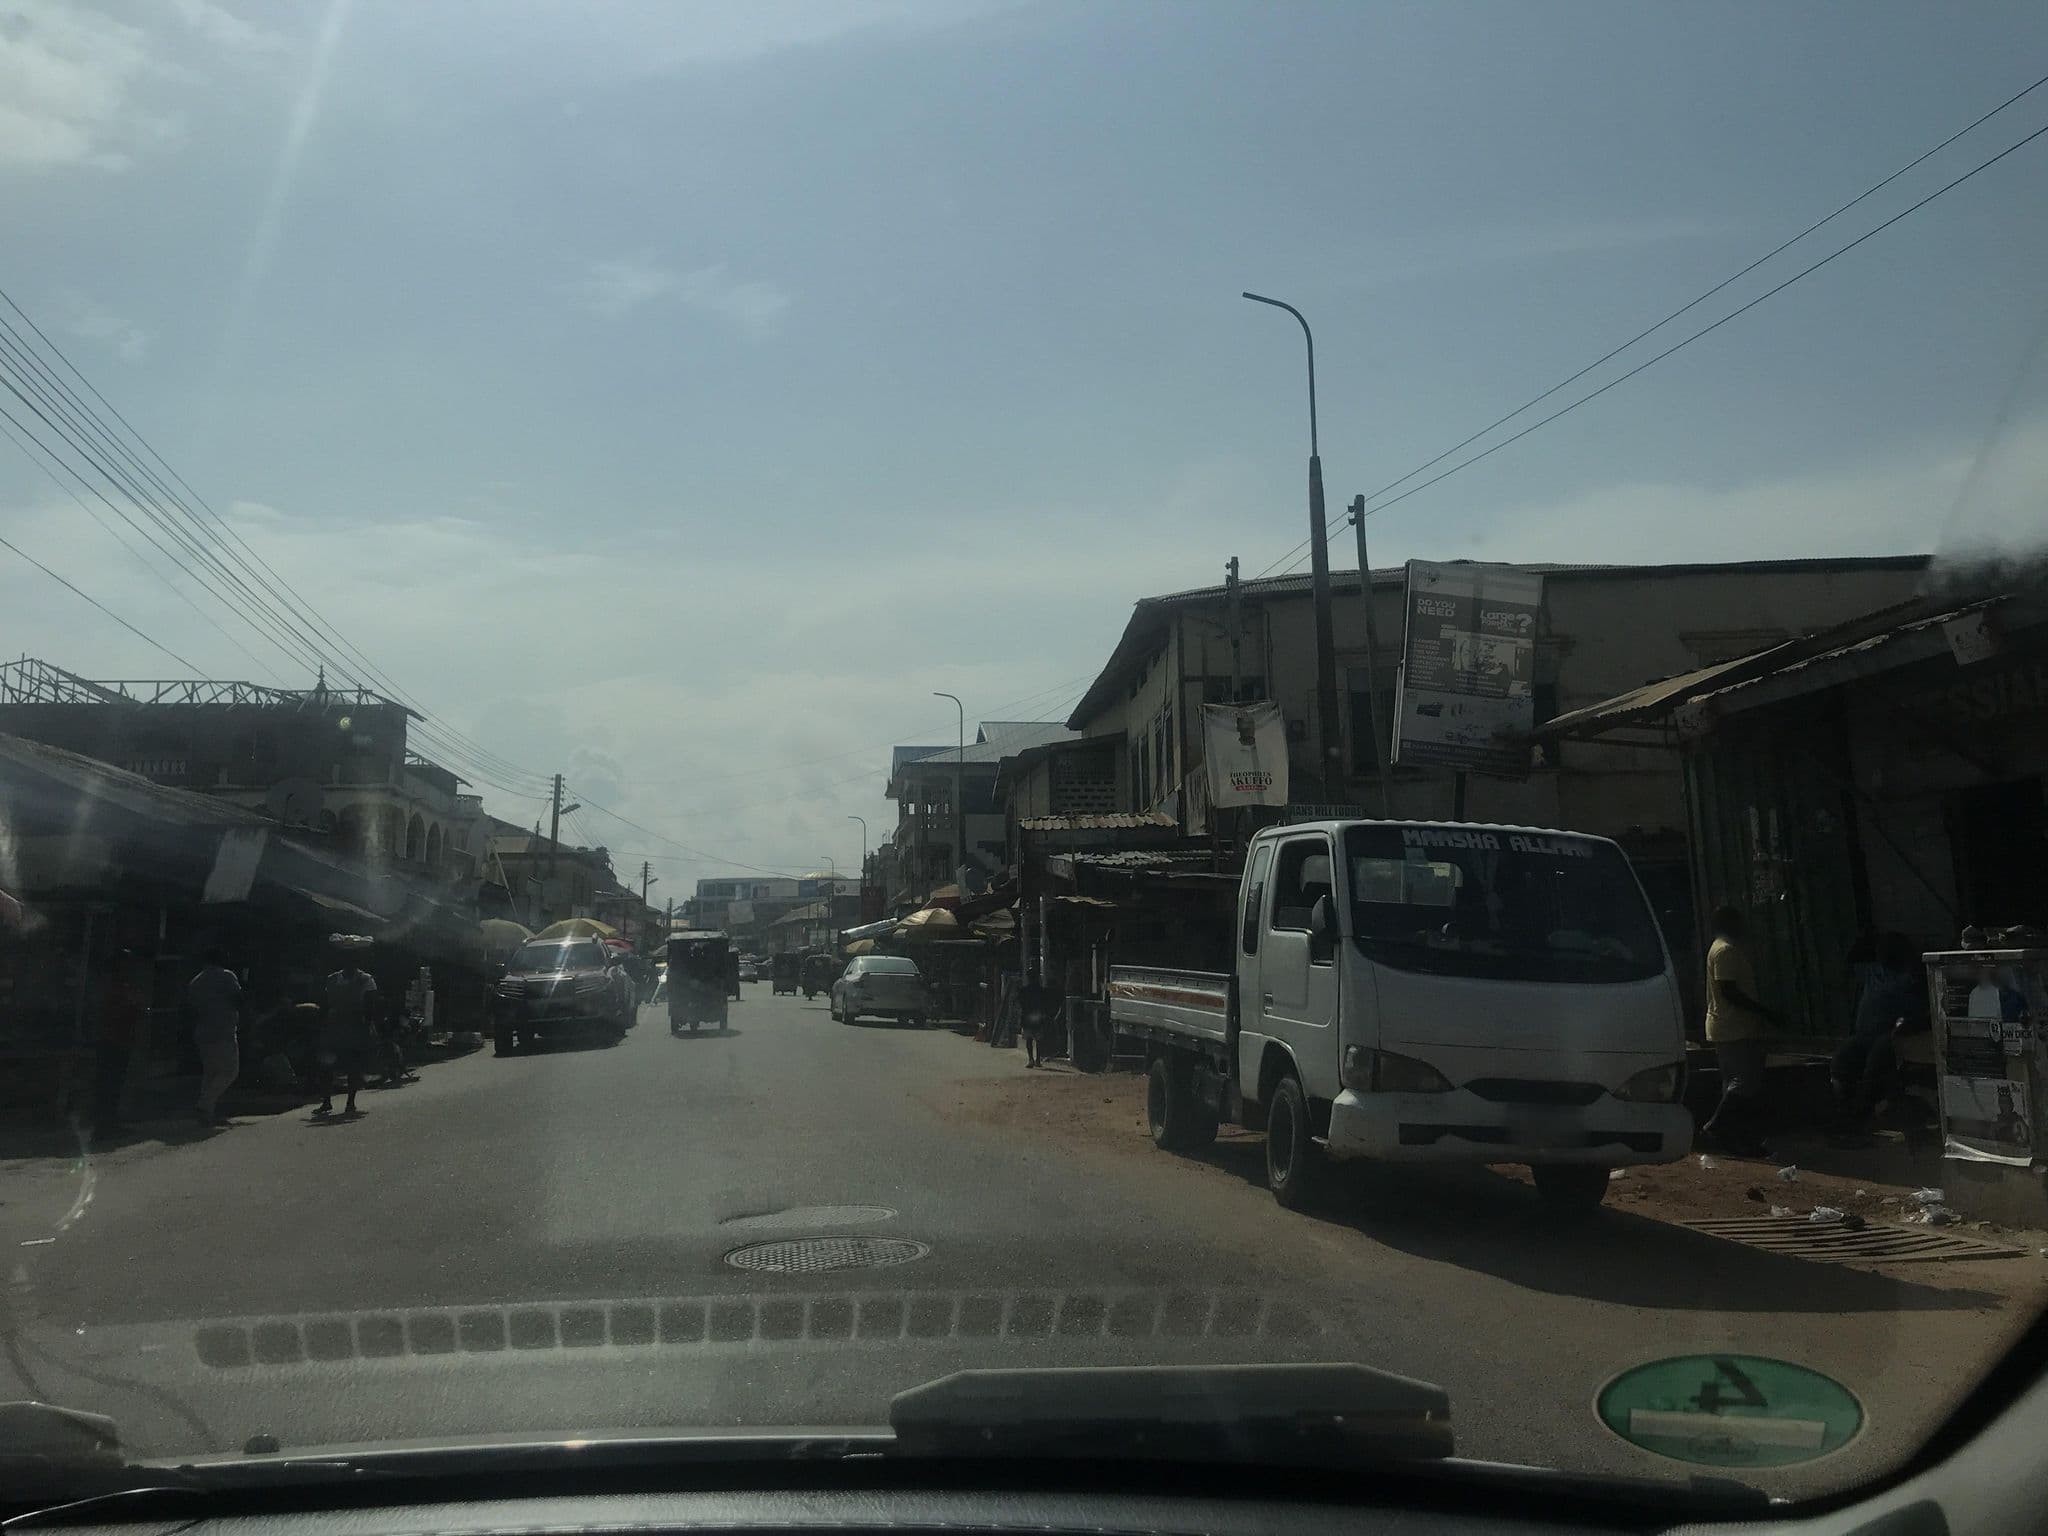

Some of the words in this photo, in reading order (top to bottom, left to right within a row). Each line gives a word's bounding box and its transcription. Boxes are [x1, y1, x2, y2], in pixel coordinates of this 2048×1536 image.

[1417, 598, 1432, 606] DO
[1434, 600, 1456, 609] YOU
[1417, 605, 1455, 617] NEED
